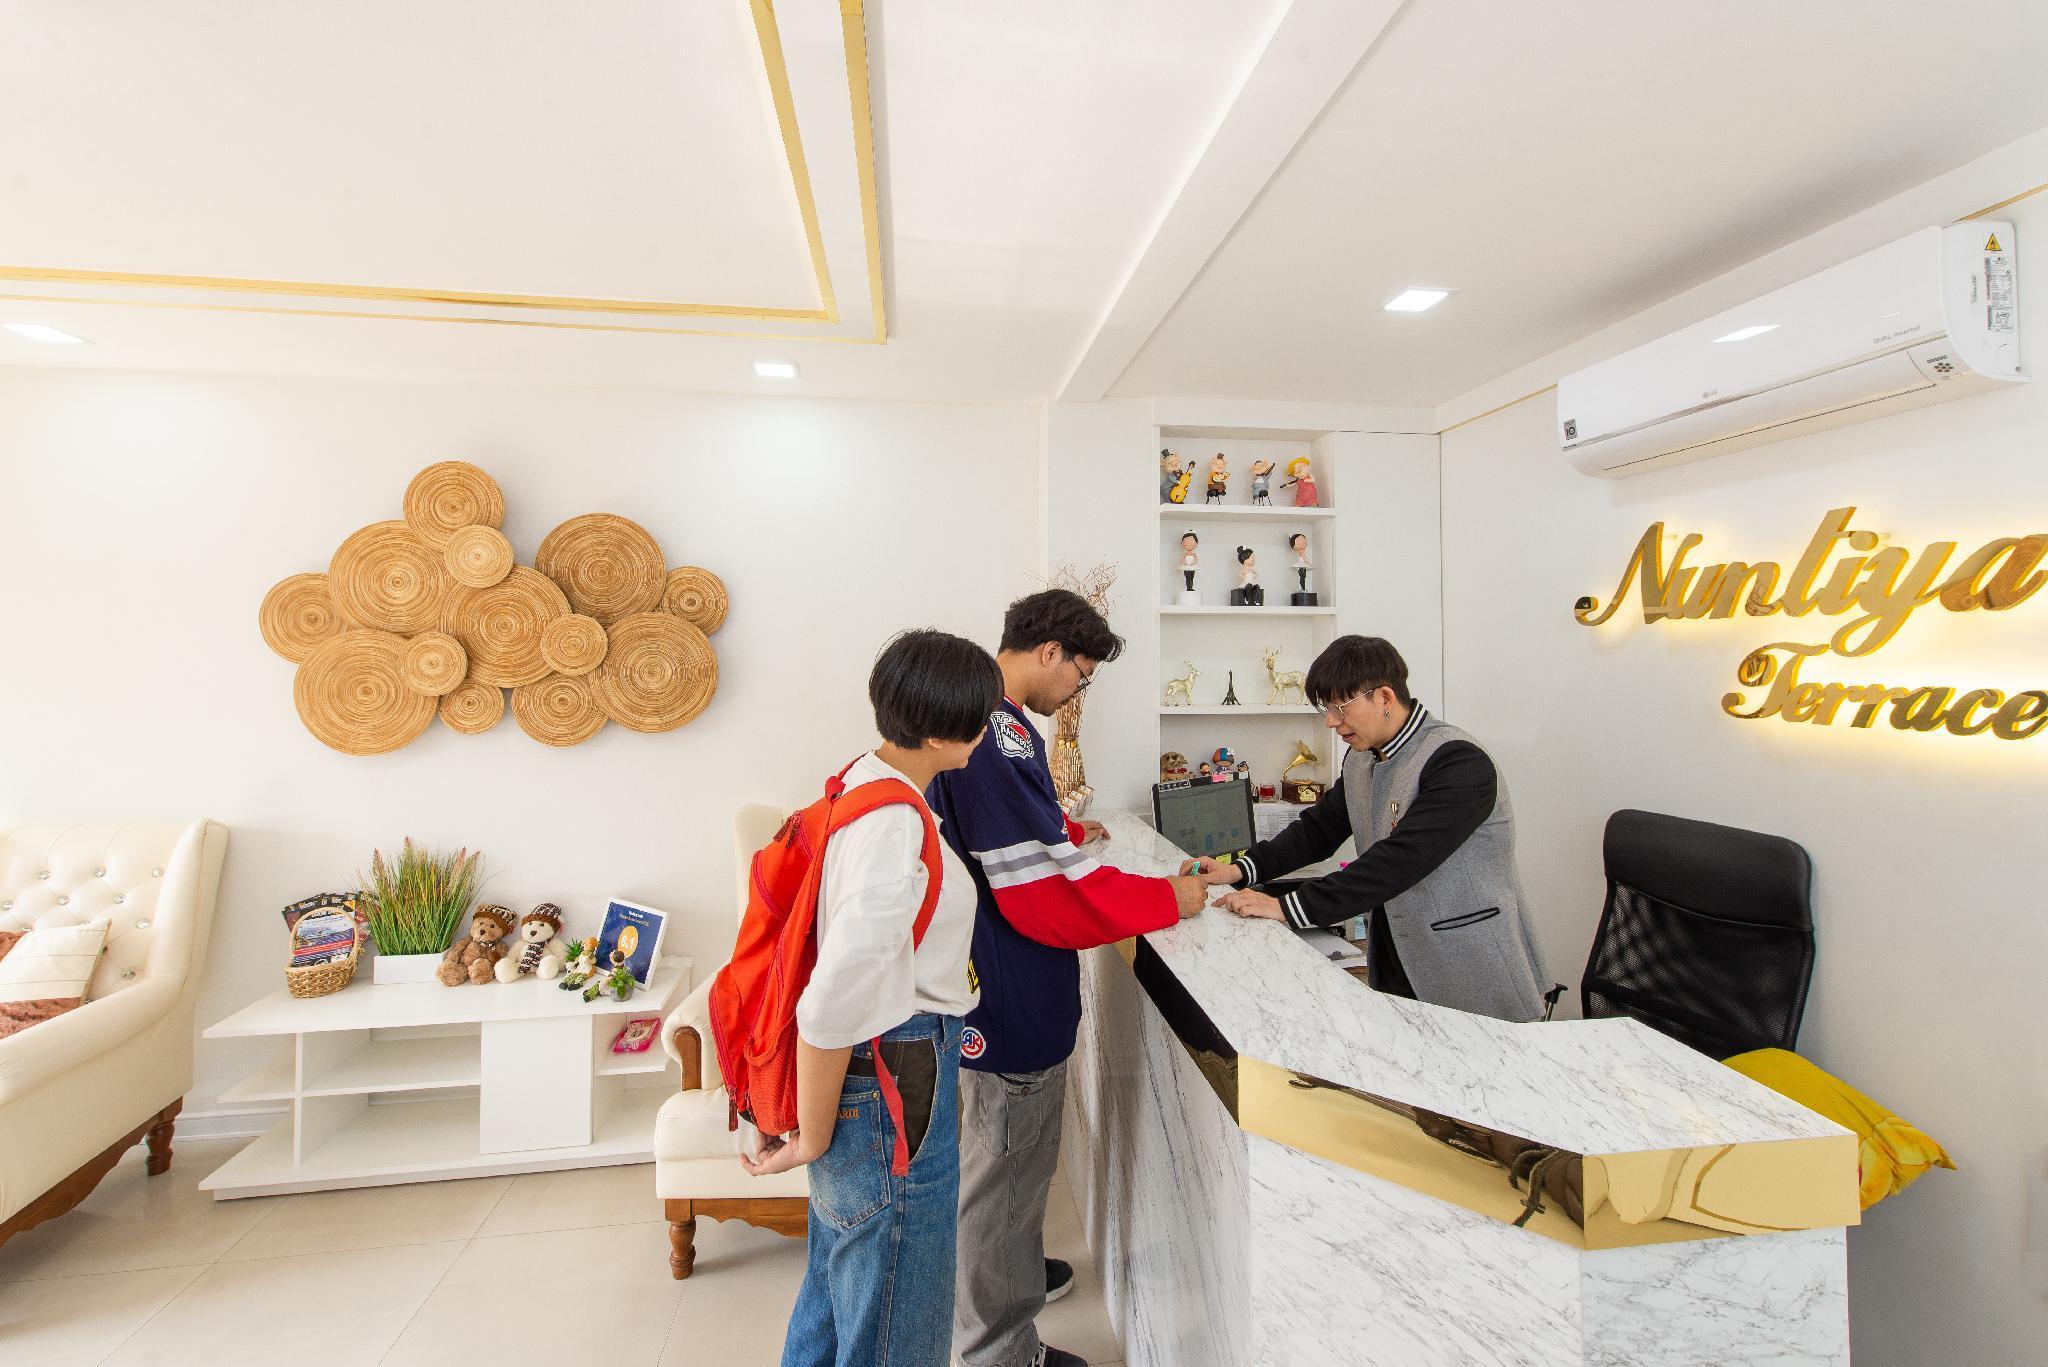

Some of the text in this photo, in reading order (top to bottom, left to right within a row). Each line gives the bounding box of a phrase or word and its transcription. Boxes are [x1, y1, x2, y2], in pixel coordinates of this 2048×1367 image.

[1574, 506, 2048, 658] Nuntiya
[1000, 723, 1031, 752] RANGERS
[1721, 641, 2048, 741] Terrace
